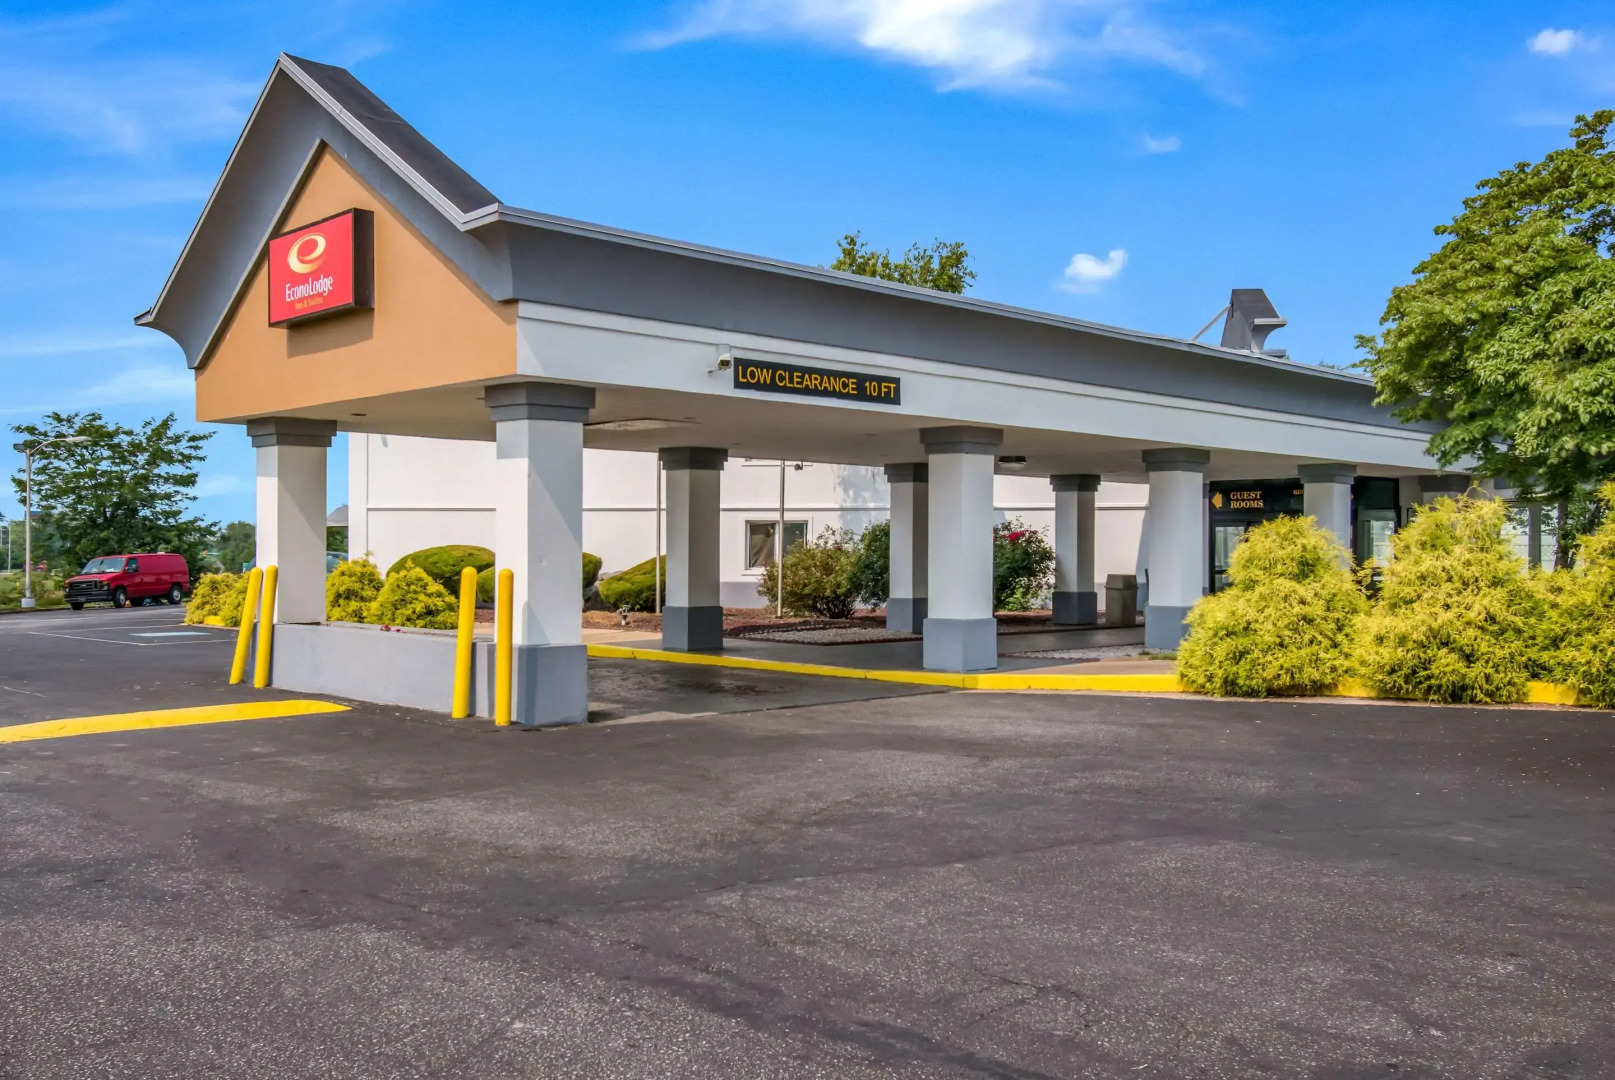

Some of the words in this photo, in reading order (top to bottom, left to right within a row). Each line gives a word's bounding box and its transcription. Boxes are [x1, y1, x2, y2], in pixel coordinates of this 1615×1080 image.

[285, 274, 334, 302] EconoLodge
[738, 365, 772, 385] LOW
[775, 370, 858, 394] CLEARANCE
[864, 381, 878, 397] 10
[881, 382, 897, 398] FT
[1230, 491, 1262, 500] GUEST
[1230, 500, 1264, 509] ROOMS
